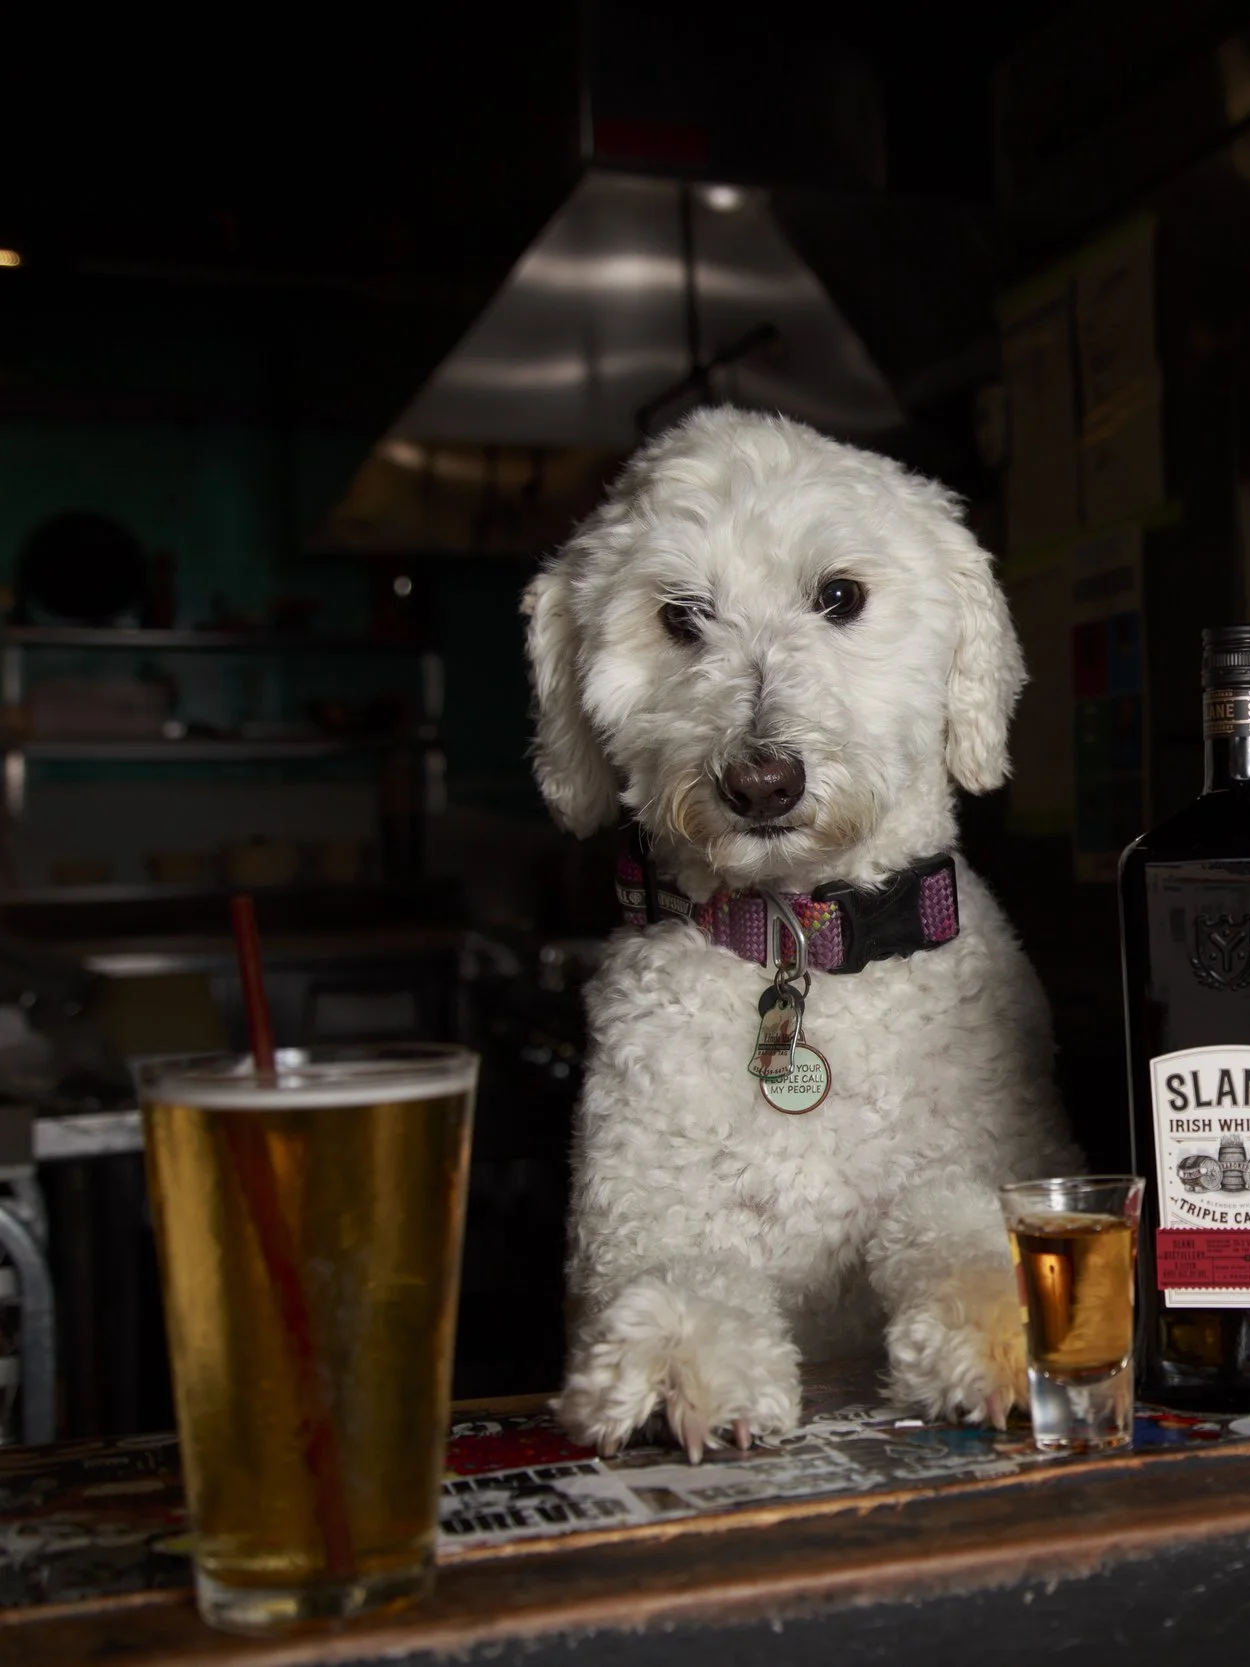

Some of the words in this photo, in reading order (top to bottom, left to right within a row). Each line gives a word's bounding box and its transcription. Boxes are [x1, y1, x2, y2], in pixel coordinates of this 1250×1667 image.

[796, 1064, 821, 1073] YOUR
[802, 1074, 824, 1083] CALL
[770, 1085, 784, 1094] MY
[788, 1085, 821, 1094] PEOPLE
[1169, 1119, 1212, 1132] IRISH
[1179, 1198, 1228, 1224] TRIPLE
